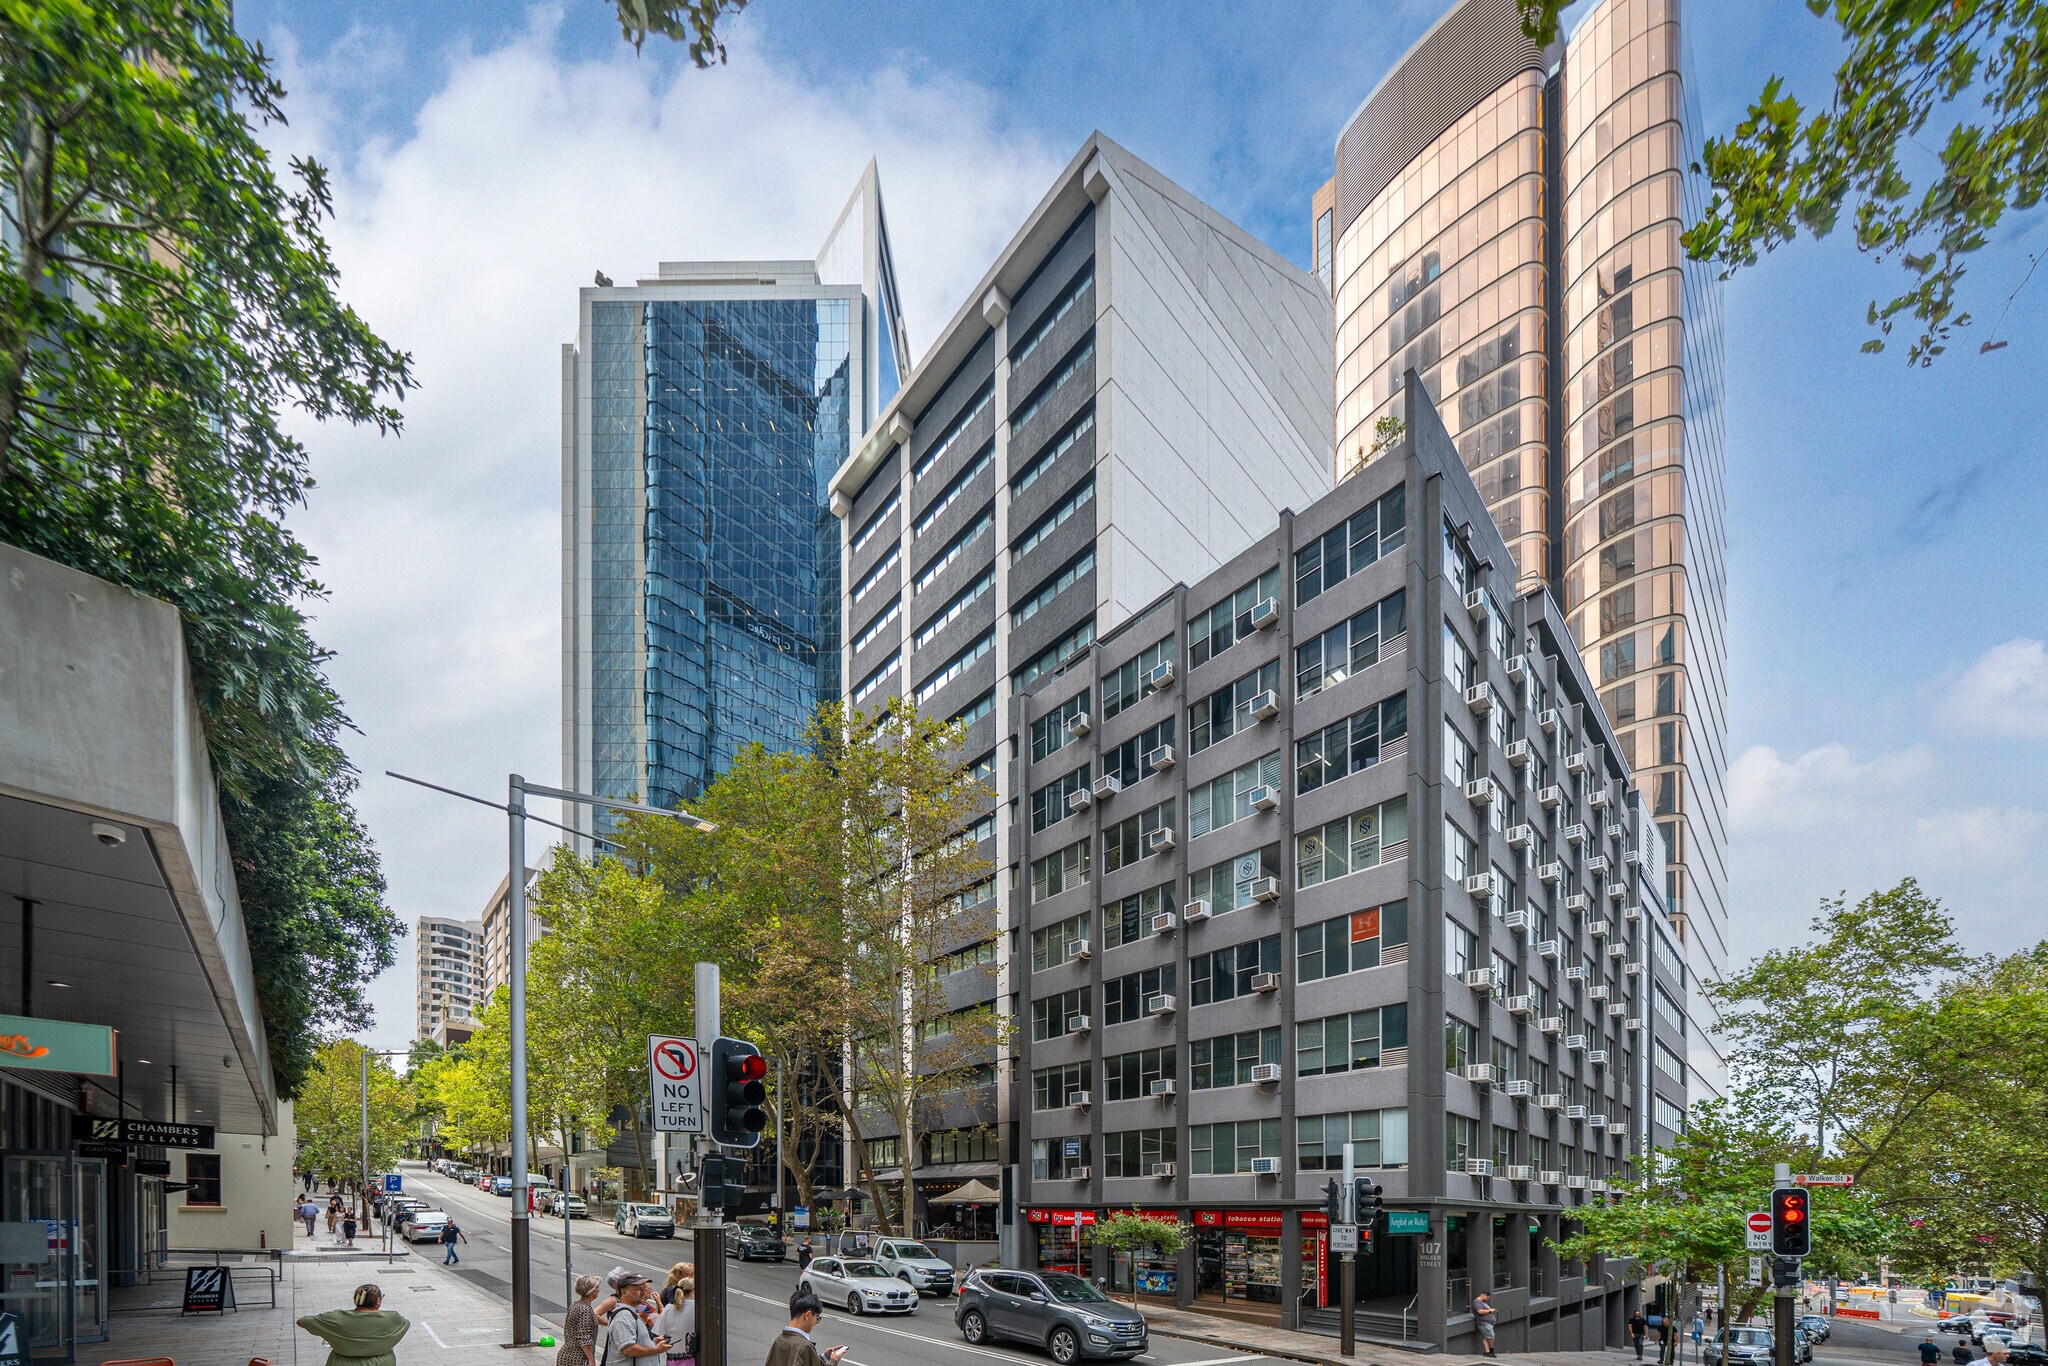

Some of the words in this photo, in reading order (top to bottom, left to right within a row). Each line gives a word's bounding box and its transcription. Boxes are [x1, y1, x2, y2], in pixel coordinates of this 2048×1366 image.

[1358, 847, 1373, 855] HEALTH
[664, 1084, 690, 1098] NO
[662, 1102, 694, 1112] LEFT
[660, 1116, 696, 1126] TURN
[128, 1123, 198, 1136] CHAMBERS
[128, 1134, 198, 1144] CELLARS
[1390, 1217, 1408, 1228] Bangkok
[1414, 1217, 1427, 1226] Walker
[1420, 1242, 1442, 1254] 107
